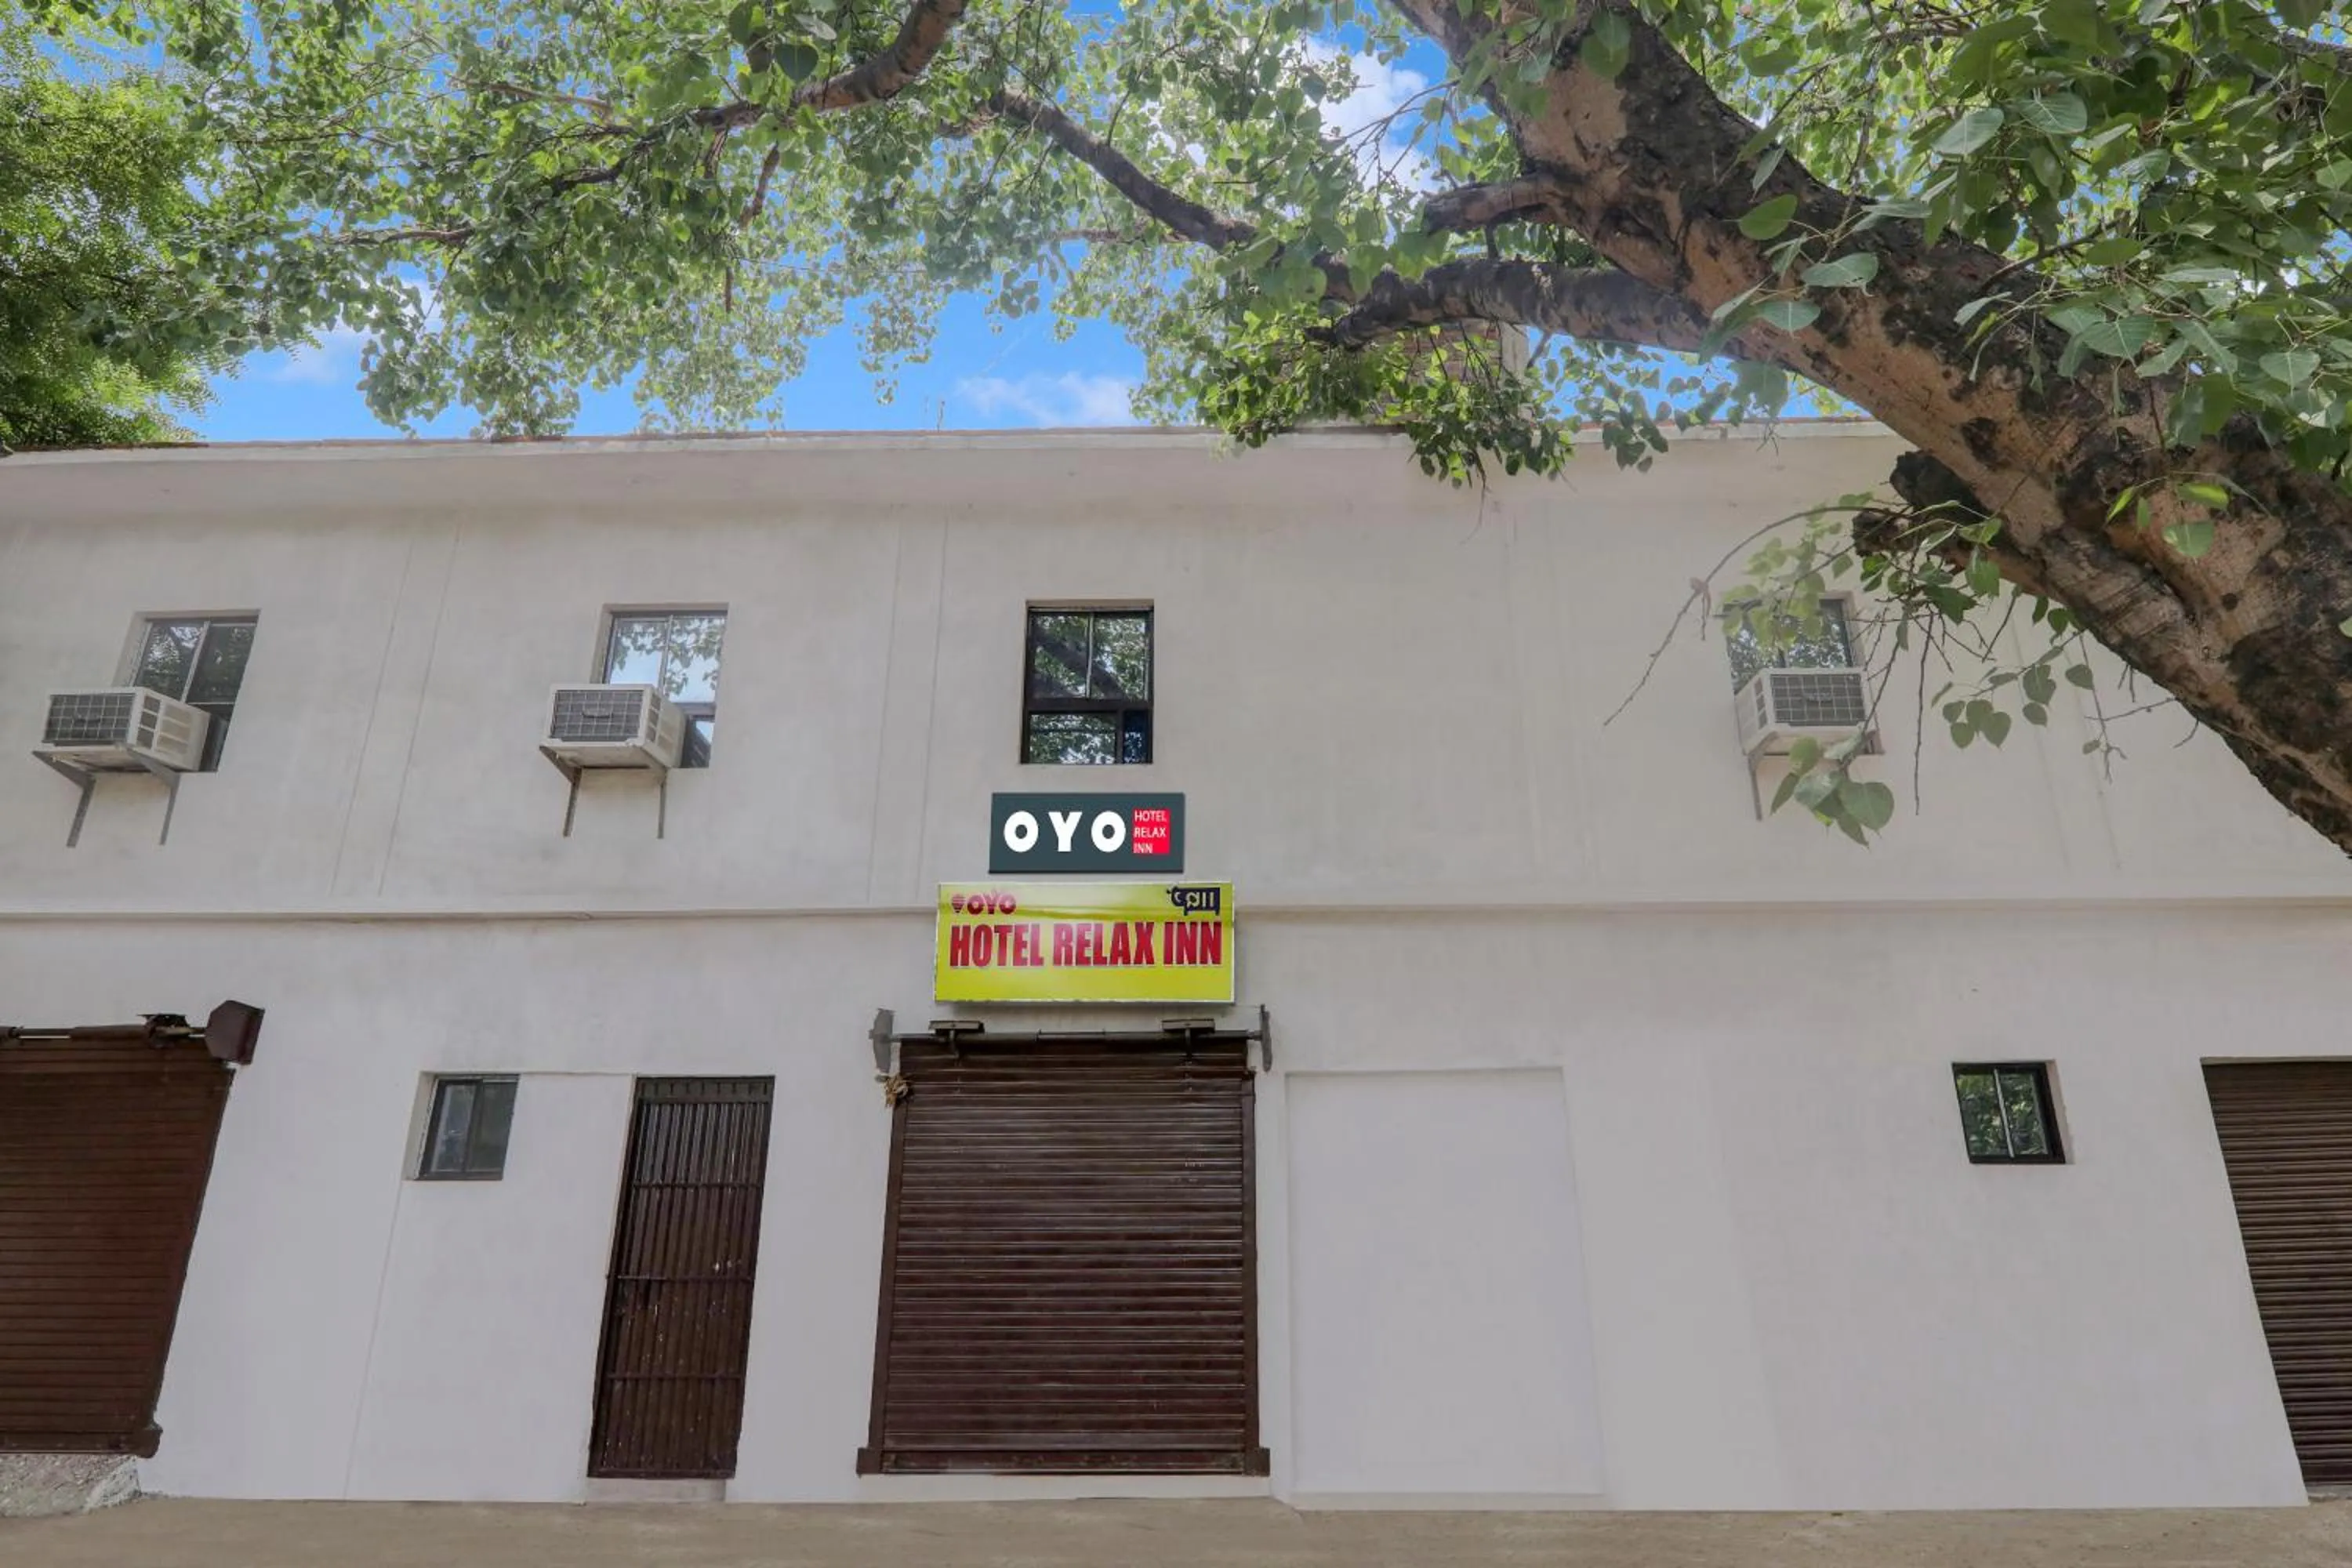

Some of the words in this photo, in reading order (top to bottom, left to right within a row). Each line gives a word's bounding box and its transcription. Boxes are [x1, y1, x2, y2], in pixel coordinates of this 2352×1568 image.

[1134, 810, 1167, 822] HOTEL
[1004, 811, 1126, 852] OYO
[1134, 827, 1166, 838] RELAX
[1133, 844, 1152, 854] INN
[967, 893, 1017, 916] OYO
[949, 924, 1044, 967] HOTEL
[1052, 922, 1156, 966] RELAX
[1163, 921, 1223, 965] INN
